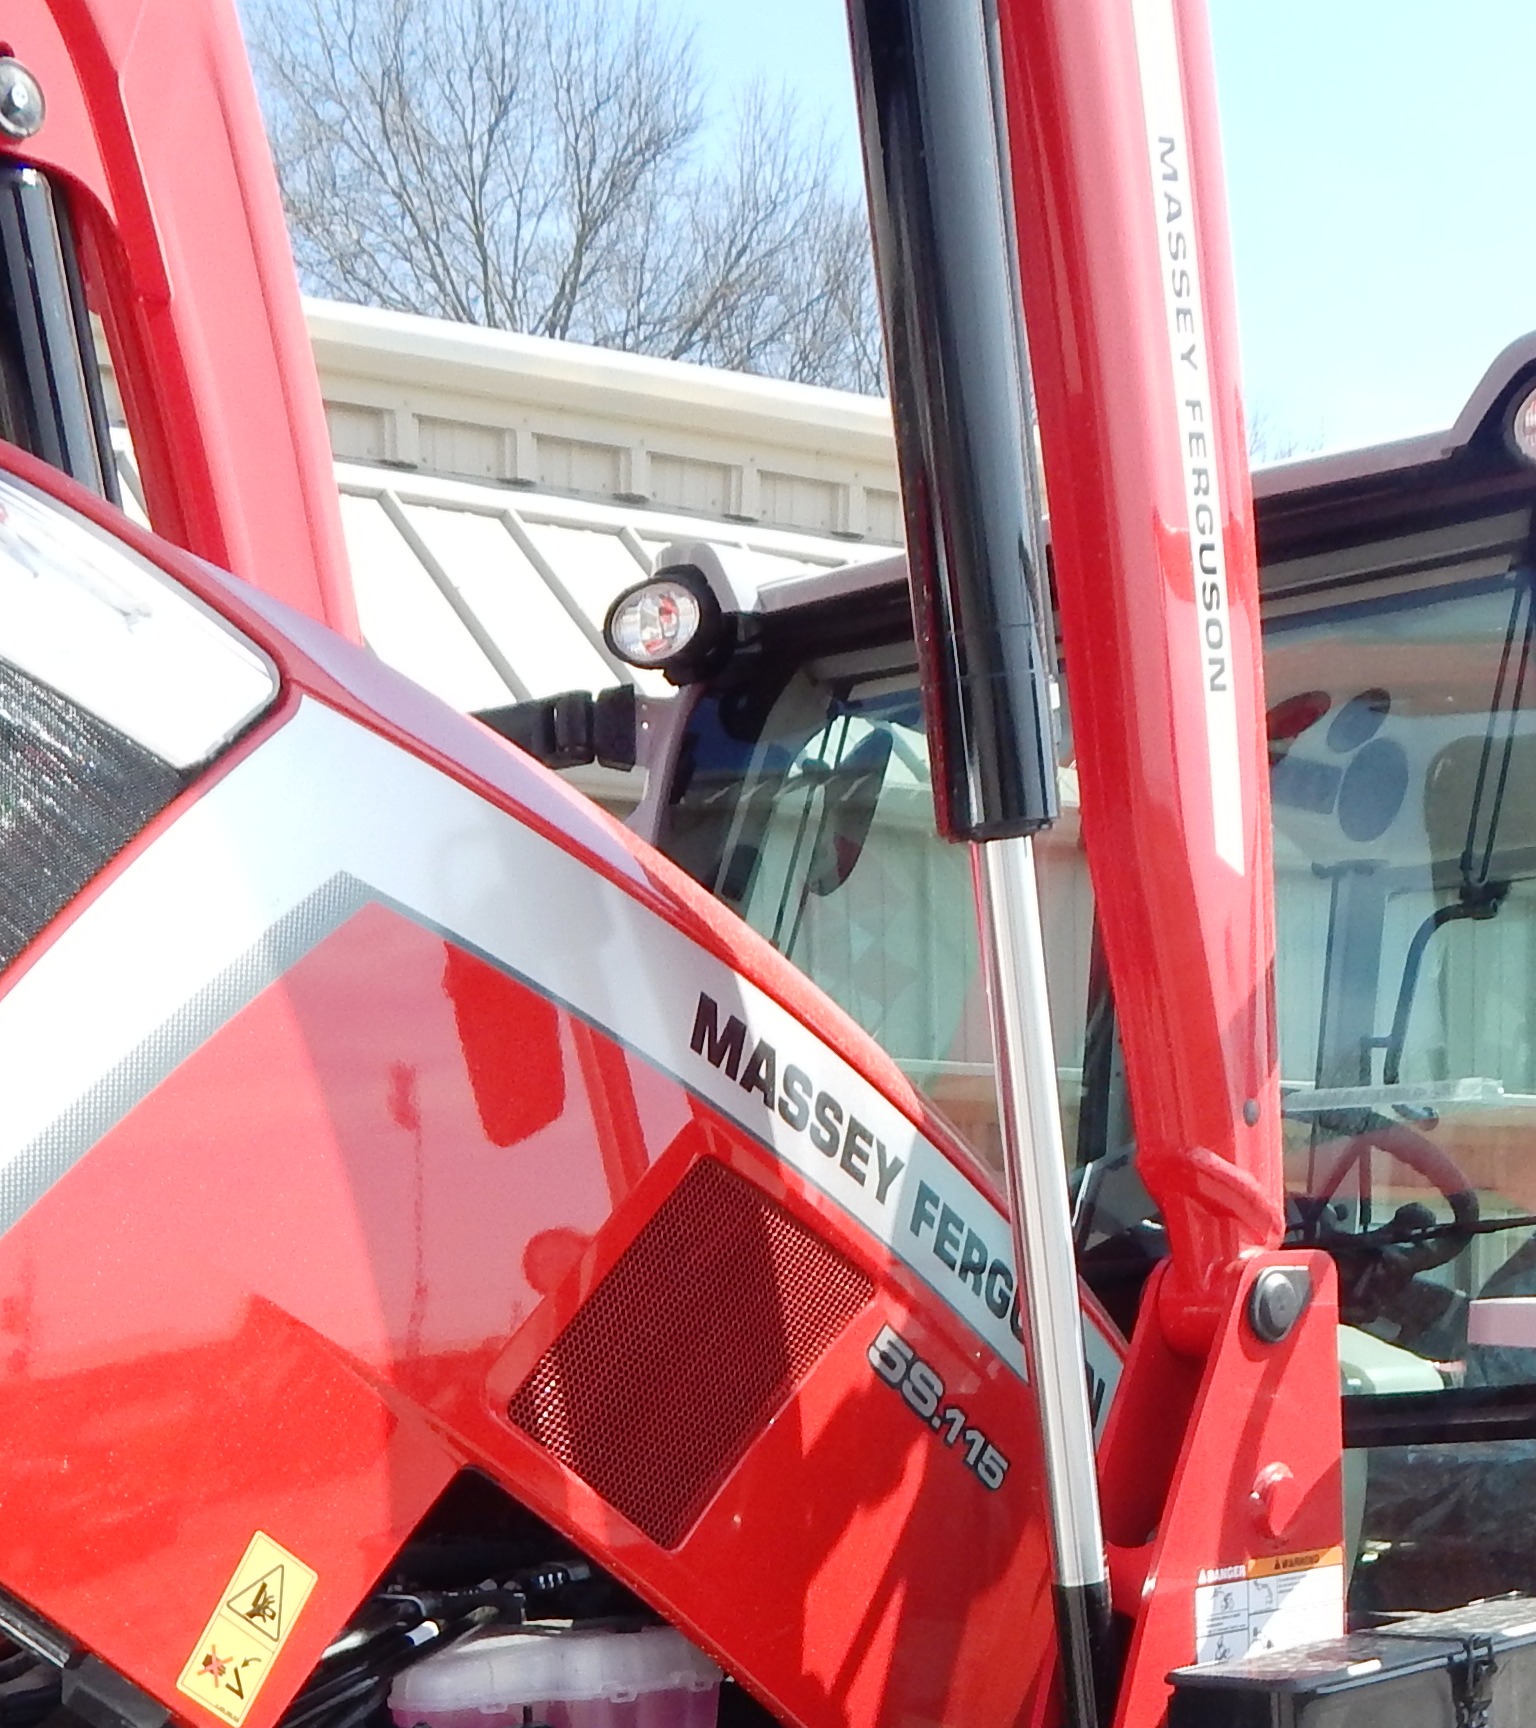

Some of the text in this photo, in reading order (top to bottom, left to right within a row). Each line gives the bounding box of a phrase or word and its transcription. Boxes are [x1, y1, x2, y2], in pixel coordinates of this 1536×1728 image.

[1156, 135, 1228, 693] MASSEY FERGUSON
[689, 990, 905, 1206] MASSEY
[866, 1325, 1010, 1493] 5S.115
